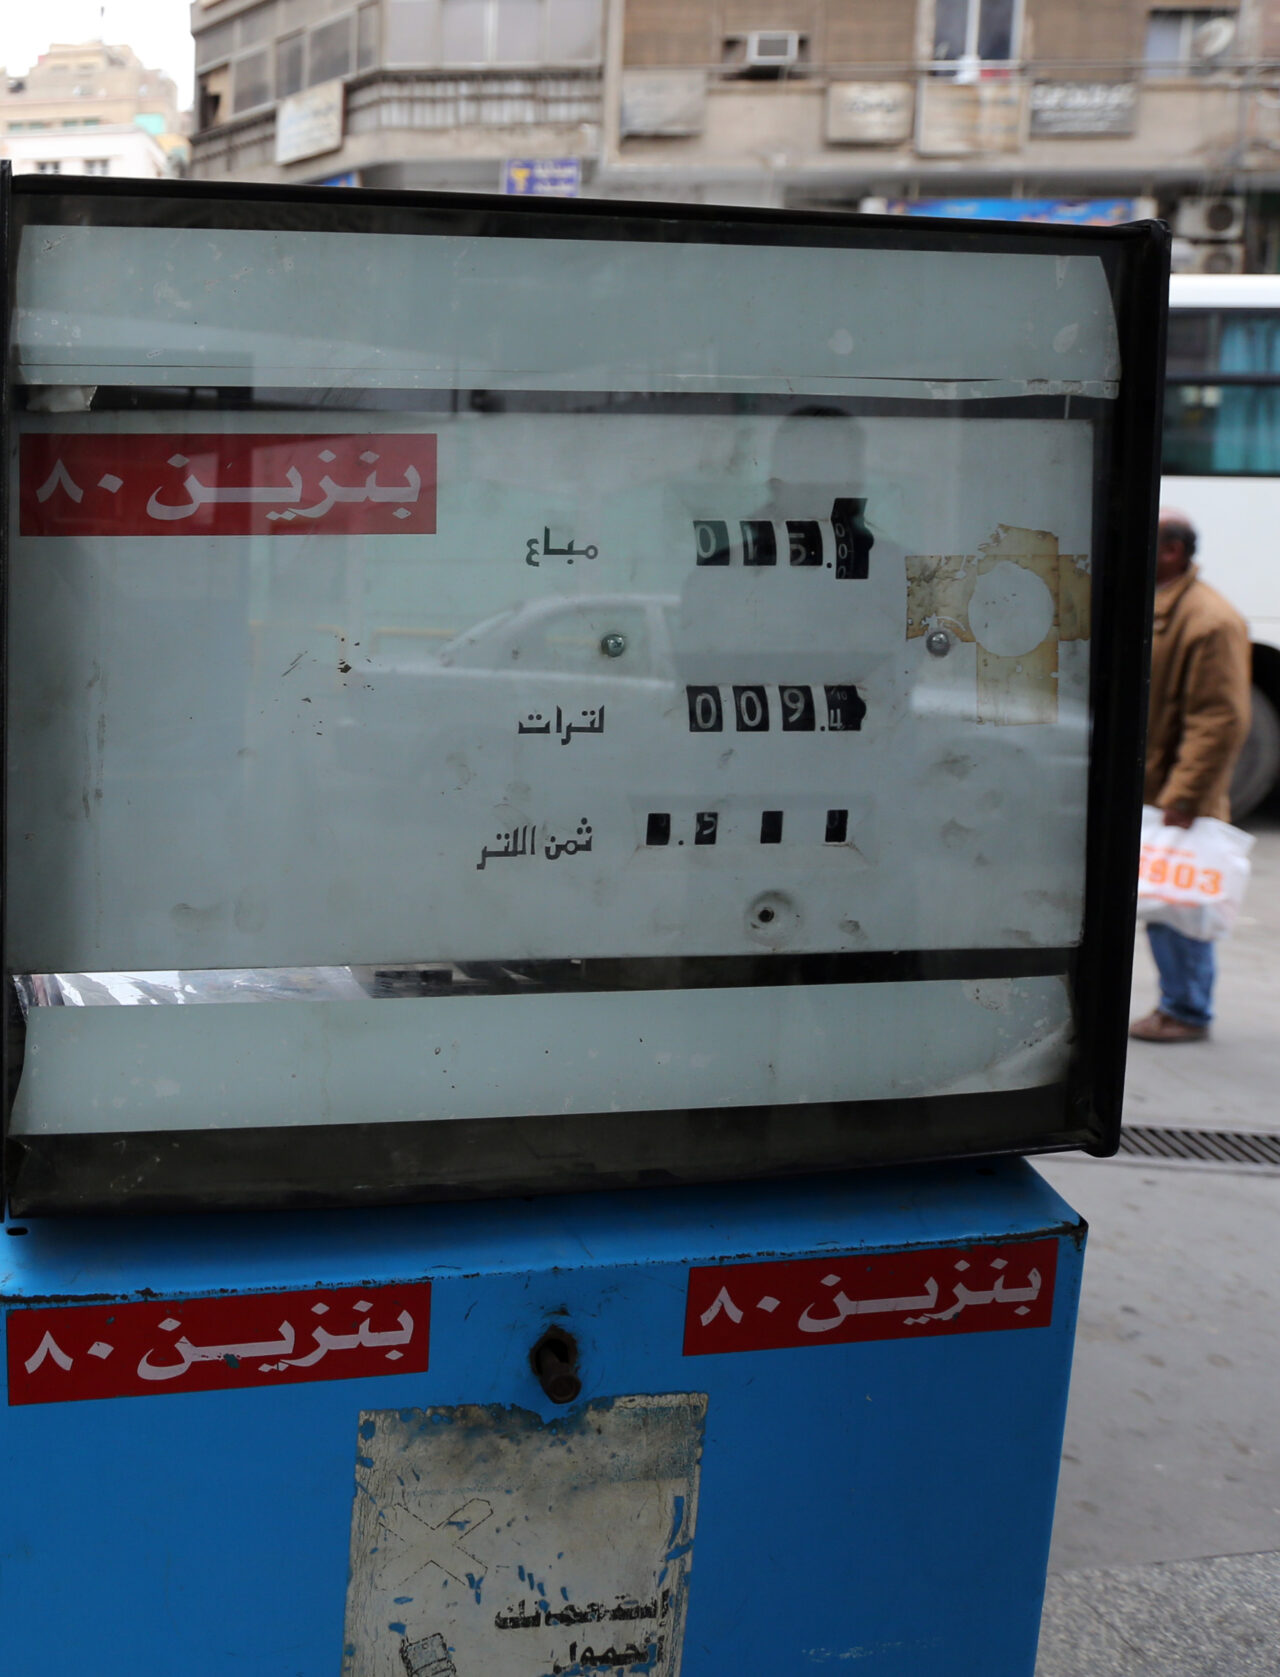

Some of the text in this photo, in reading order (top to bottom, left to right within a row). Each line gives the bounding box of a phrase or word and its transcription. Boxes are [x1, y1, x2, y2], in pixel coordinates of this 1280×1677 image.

[36, 449, 421, 521] بنزين ٨٠
[525, 526, 598, 567] مباع
[518, 705, 605, 745] لترات
[477, 817, 592, 870] ثمن اللتر
[700, 1258, 1042, 1333] بنزين ٨٠
[24, 1299, 415, 1381] بنزين ٨٠
